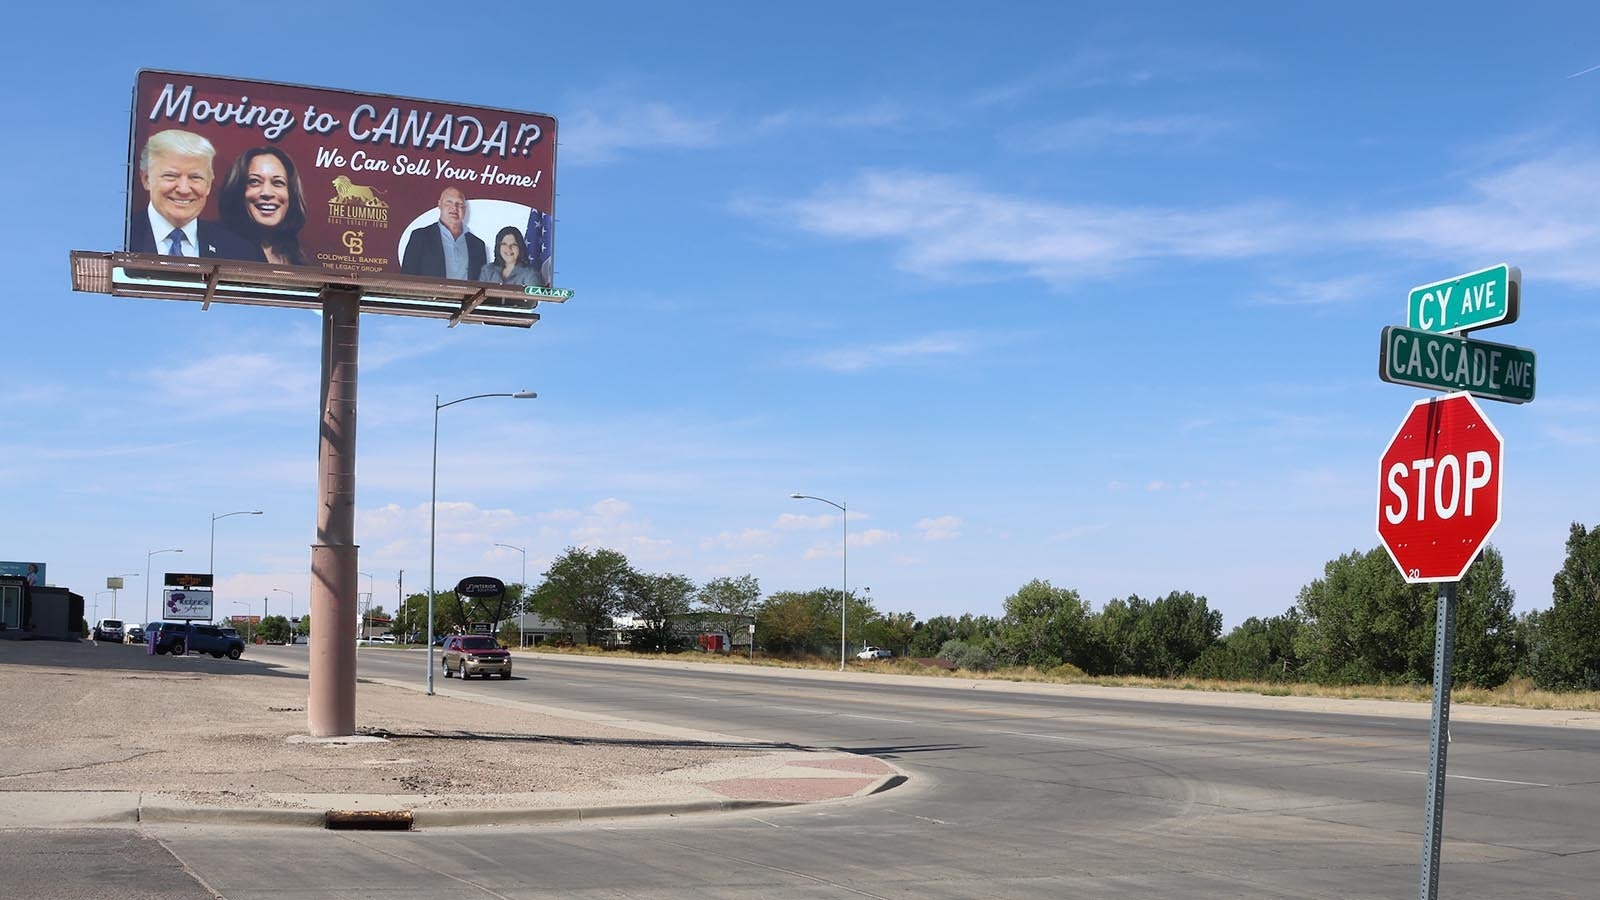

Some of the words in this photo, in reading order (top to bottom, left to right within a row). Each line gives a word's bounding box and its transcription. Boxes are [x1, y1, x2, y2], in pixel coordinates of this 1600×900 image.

[150, 83, 295, 139] Moving
[303, 105, 340, 132] to
[348, 103, 541, 156] CANADA!?
[315, 146, 347, 168] We
[350, 150, 389, 172] Can
[392, 155, 431, 176] Sell
[435, 159, 478, 181] Your
[480, 165, 542, 188] Home!
[328, 204, 345, 217] THE
[347, 206, 388, 221] LUMMUS
[347, 219, 367, 227] ESTATE
[373, 221, 388, 229] TEAM
[317, 253, 357, 263] COLDWELL
[358, 256, 388, 265] BANKER
[335, 263, 360, 271] LEGACY
[528, 287, 569, 297] LAMAR
[1418, 287, 1453, 330] CY
[1461, 280, 1496, 315] AVE
[1393, 334, 1502, 390] CASCADE
[1504, 359, 1532, 388] AVE
[1385, 450, 1492, 525] STOP
[1408, 568, 1420, 579] 20
